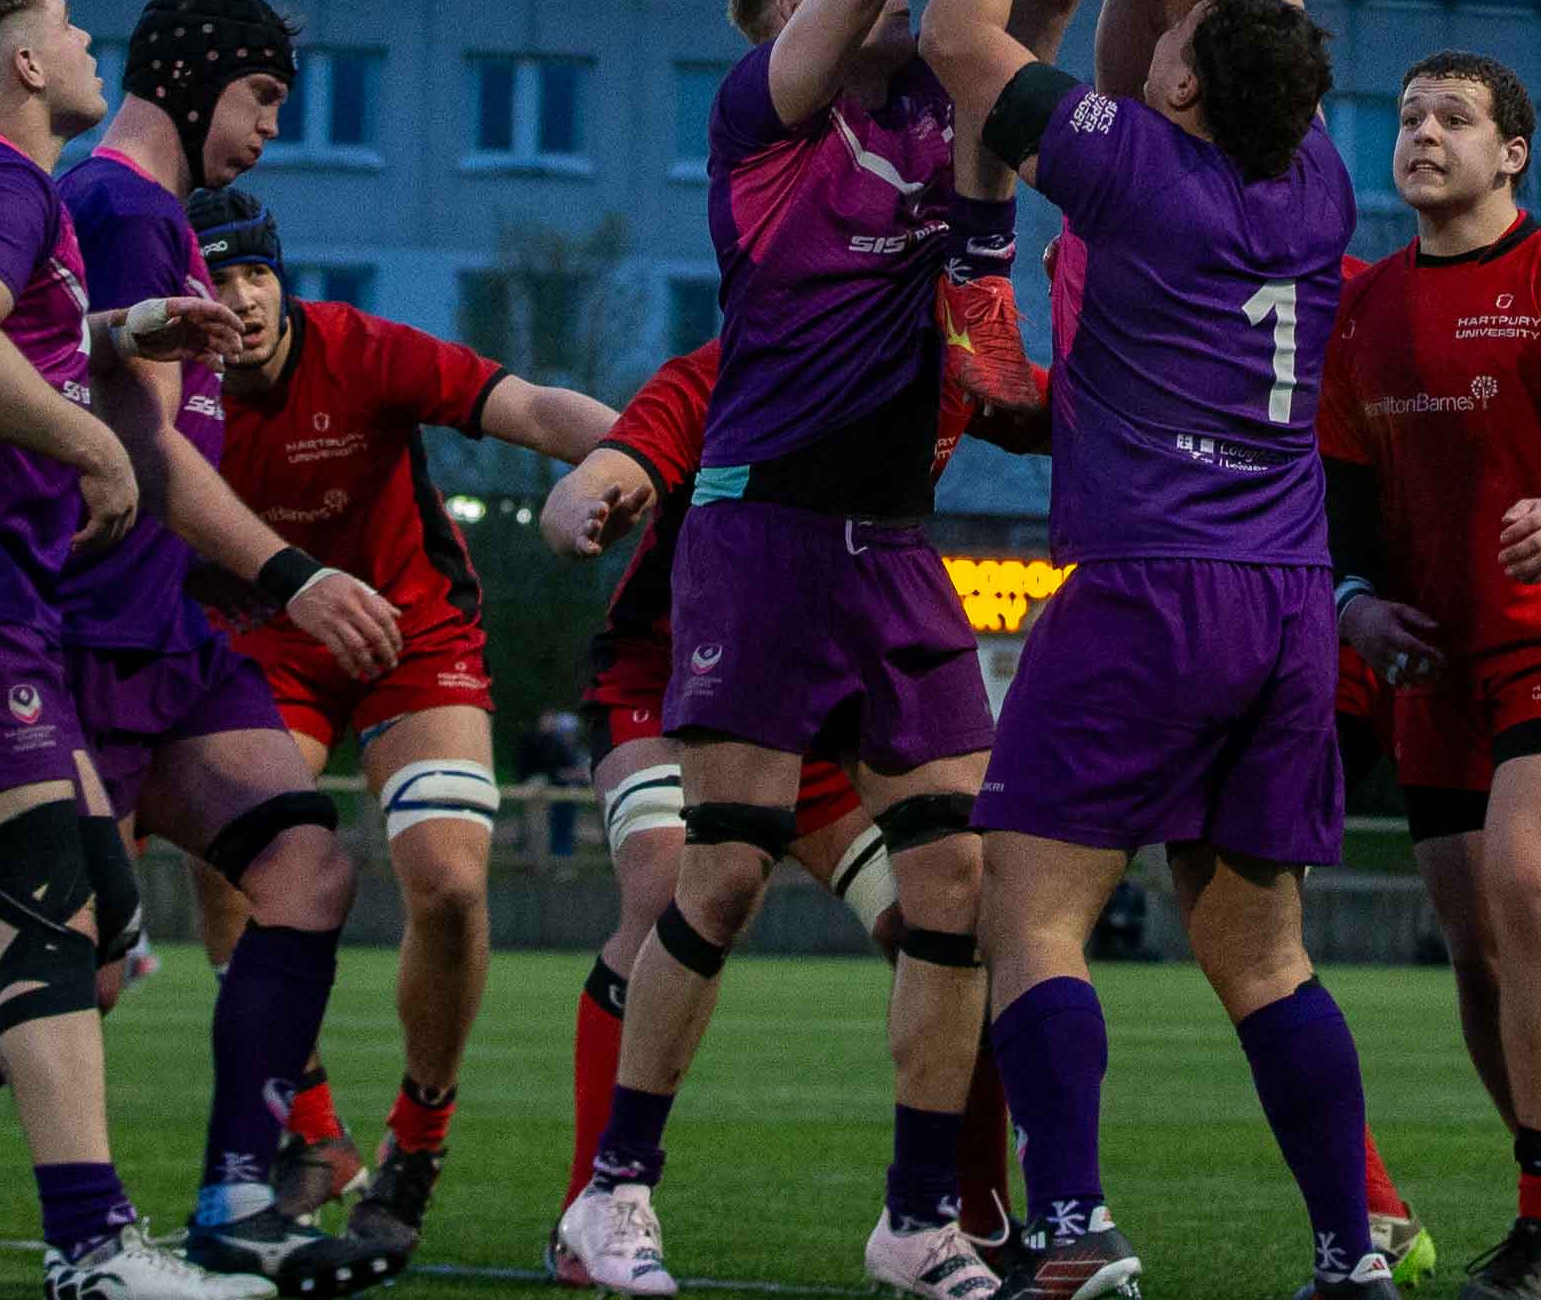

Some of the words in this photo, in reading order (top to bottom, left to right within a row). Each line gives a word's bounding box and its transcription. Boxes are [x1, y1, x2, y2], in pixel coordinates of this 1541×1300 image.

[848, 230, 908, 254] SIS
[1457, 315, 1541, 328] HARTPURY
[1455, 327, 1541, 340] UNIVERSITY
[1242, 283, 1297, 424] 1
